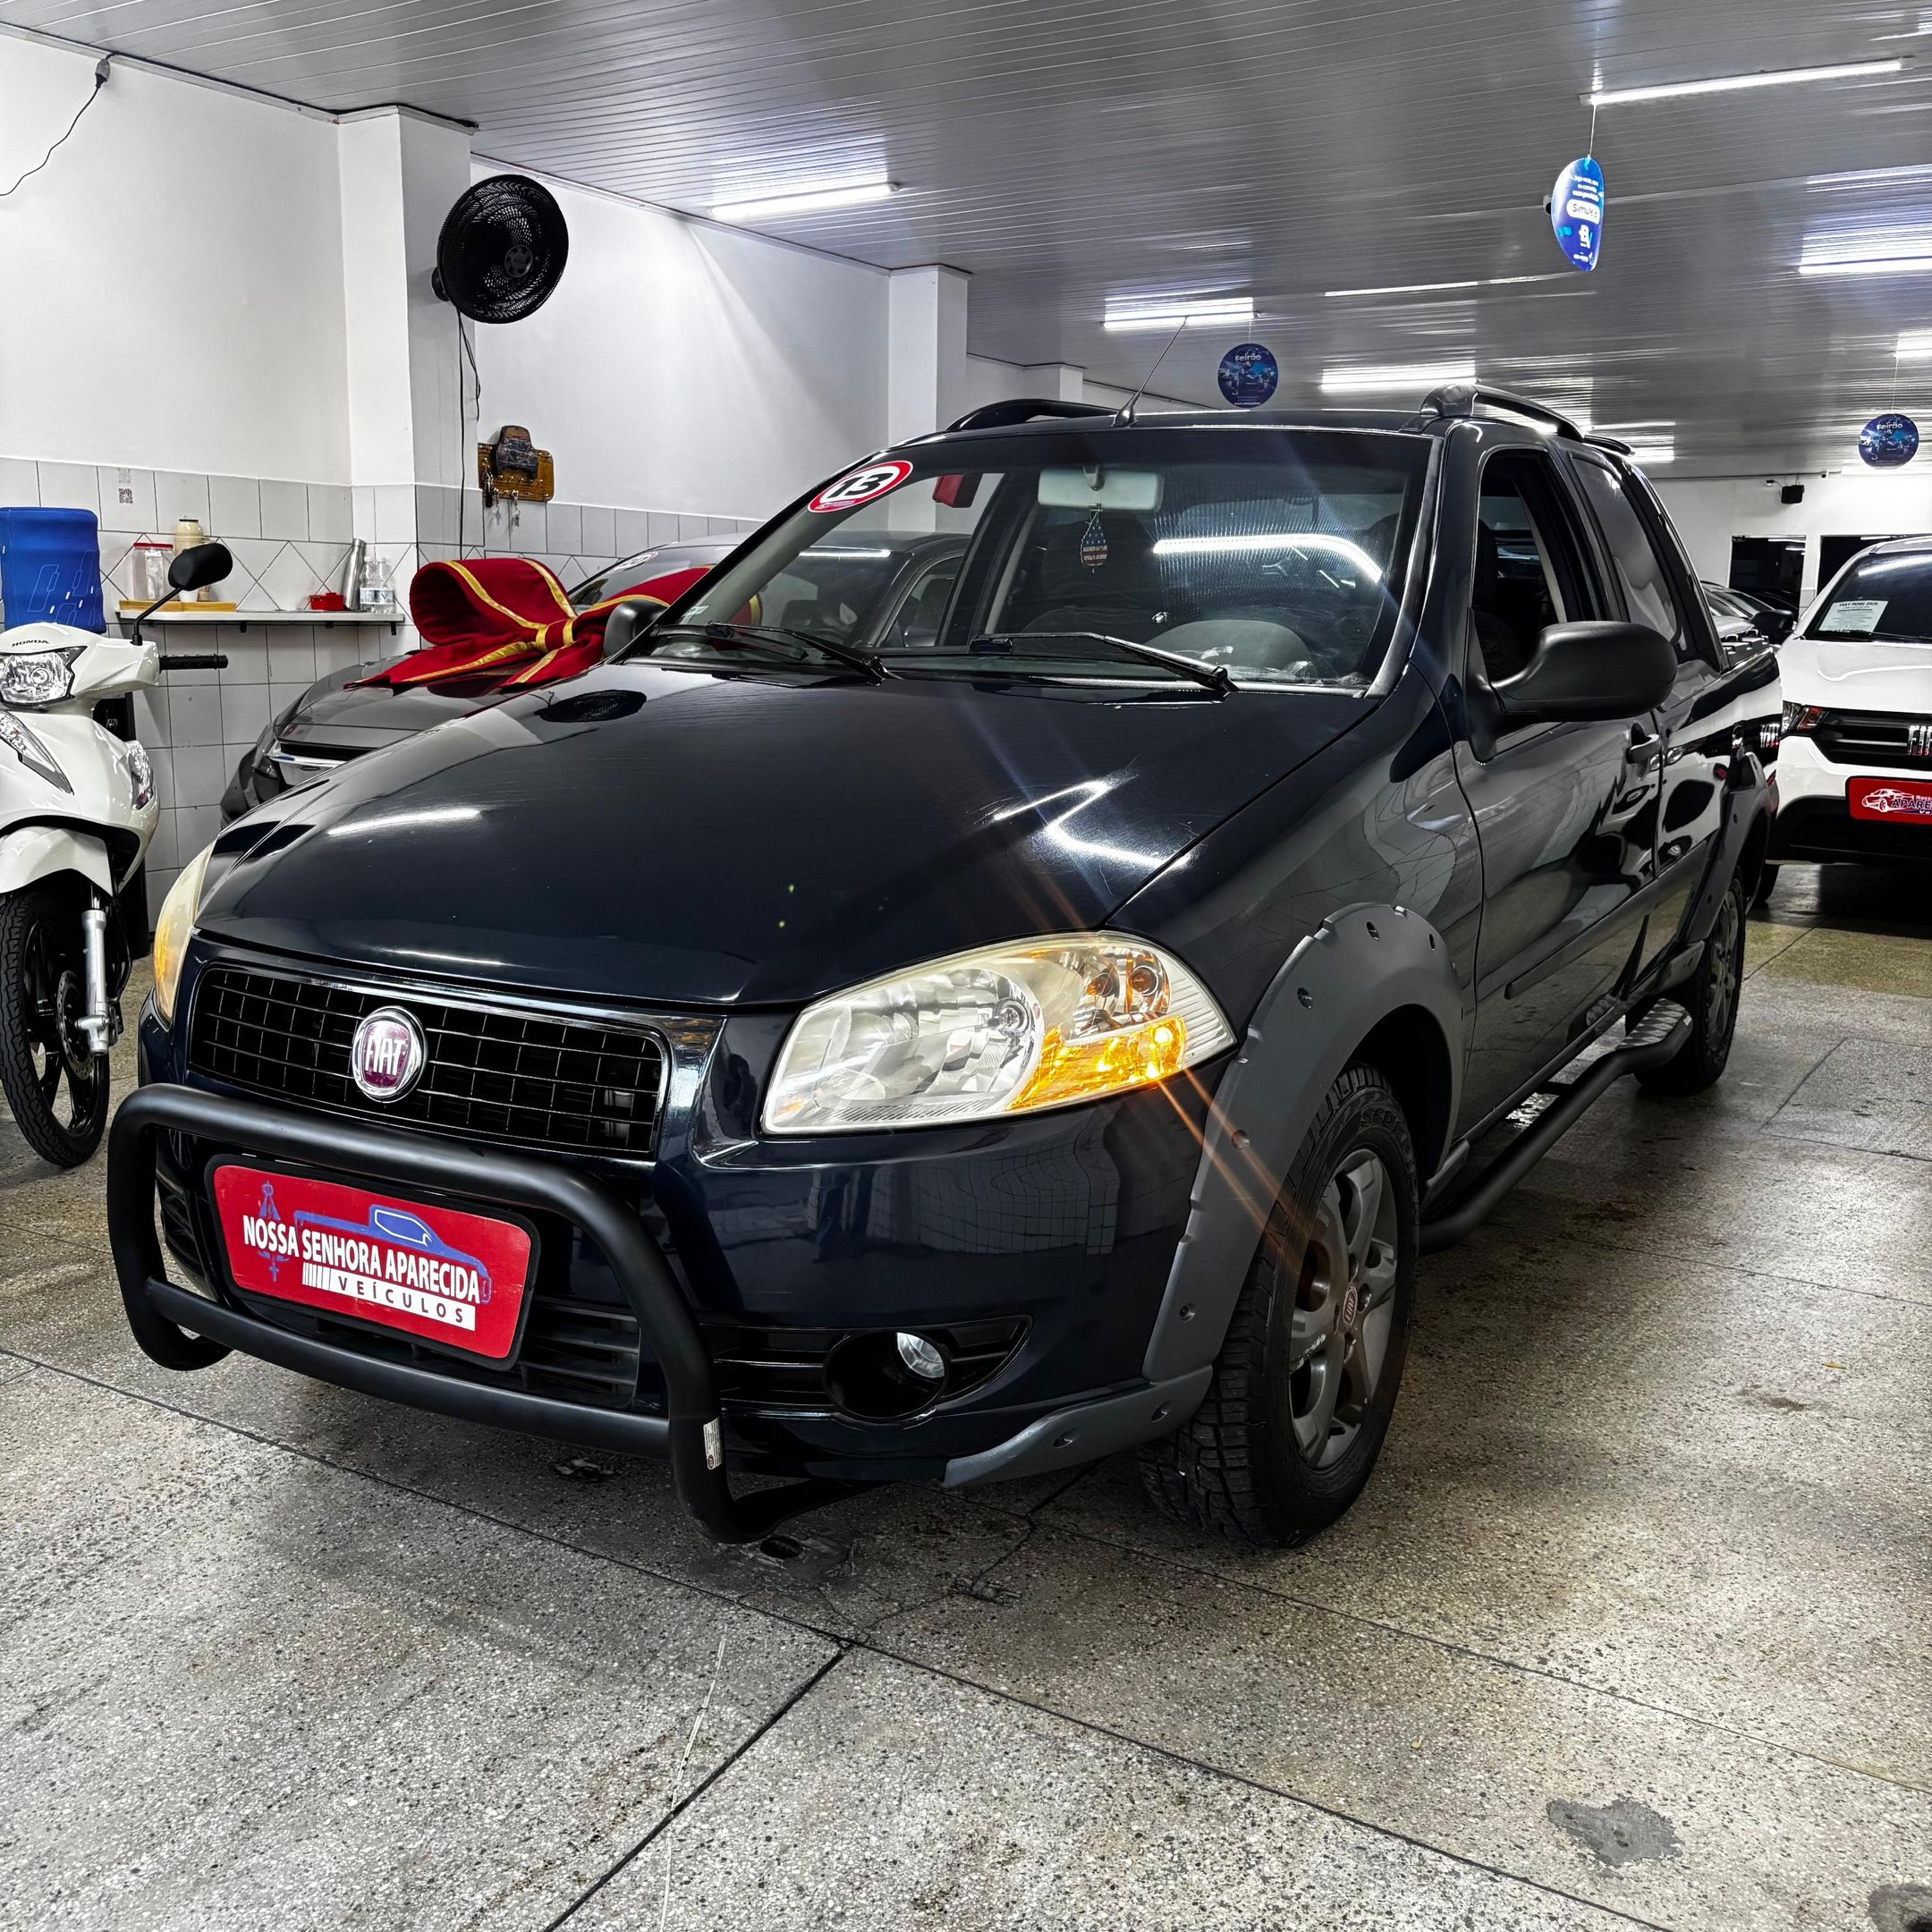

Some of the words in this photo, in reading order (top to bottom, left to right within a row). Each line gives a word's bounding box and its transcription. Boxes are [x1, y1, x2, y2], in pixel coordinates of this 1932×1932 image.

[826, 472, 894, 499] 13
[364, 1035, 407, 1076] FIAT
[242, 1215, 300, 1257] NOSSA
[301, 1229, 383, 1277] SENHORA
[385, 1249, 480, 1304] APARECIDA
[338, 1275, 463, 1323] VEÍCULOS
